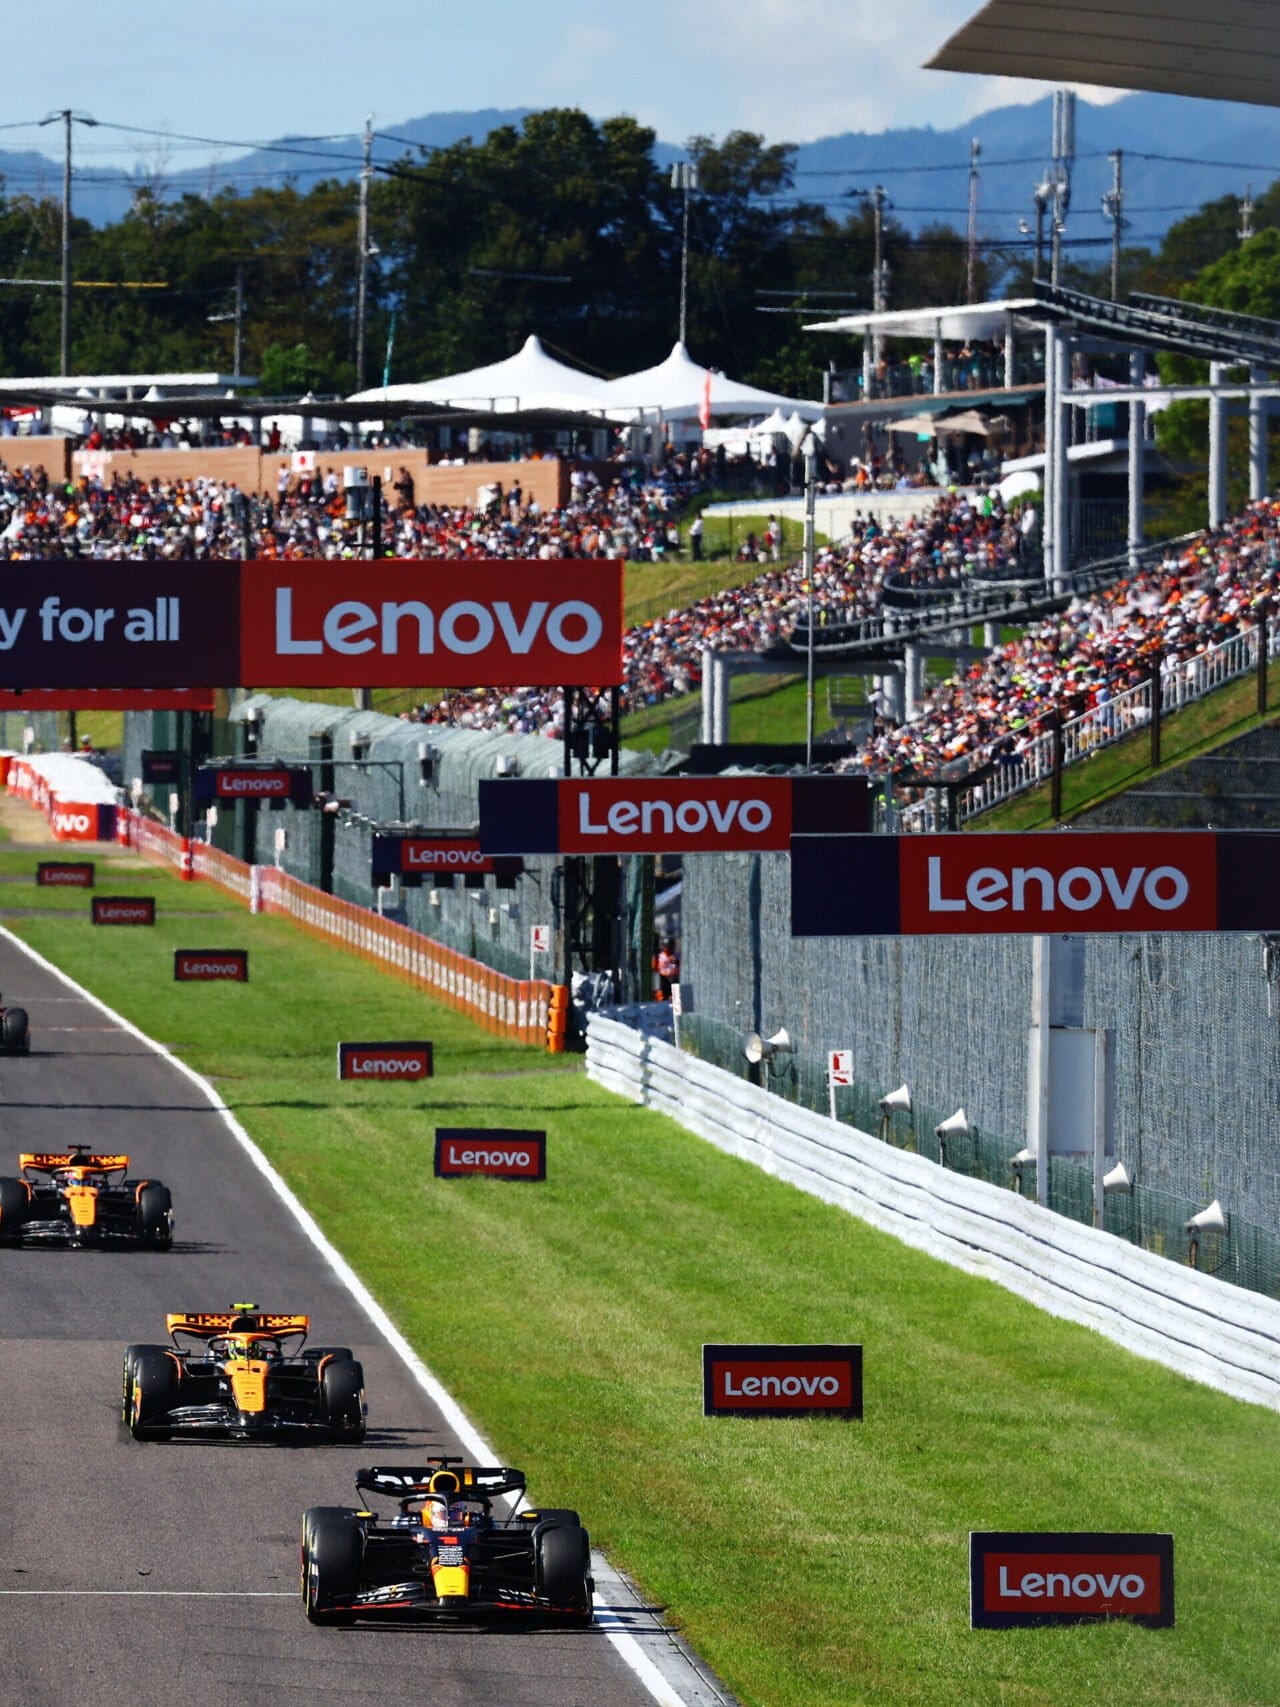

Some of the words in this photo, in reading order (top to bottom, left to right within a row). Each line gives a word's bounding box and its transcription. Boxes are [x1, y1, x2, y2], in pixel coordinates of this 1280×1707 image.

[38, 596, 115, 642] for
[124, 597, 180, 642] all
[275, 587, 603, 655] Lenovo
[222, 772, 284, 791] Lenovo
[579, 792, 772, 835] Lenovo
[409, 847, 484, 865] Lenovo
[928, 856, 1189, 912] Lenovo
[99, 907, 148, 918] Lenovo
[183, 961, 238, 974] Lenovo
[352, 1057, 422, 1074] Lenovo
[449, 1146, 530, 1168] Lenovo
[723, 1368, 840, 1398] Lenovo
[999, 1565, 1146, 1599] Lenovo
